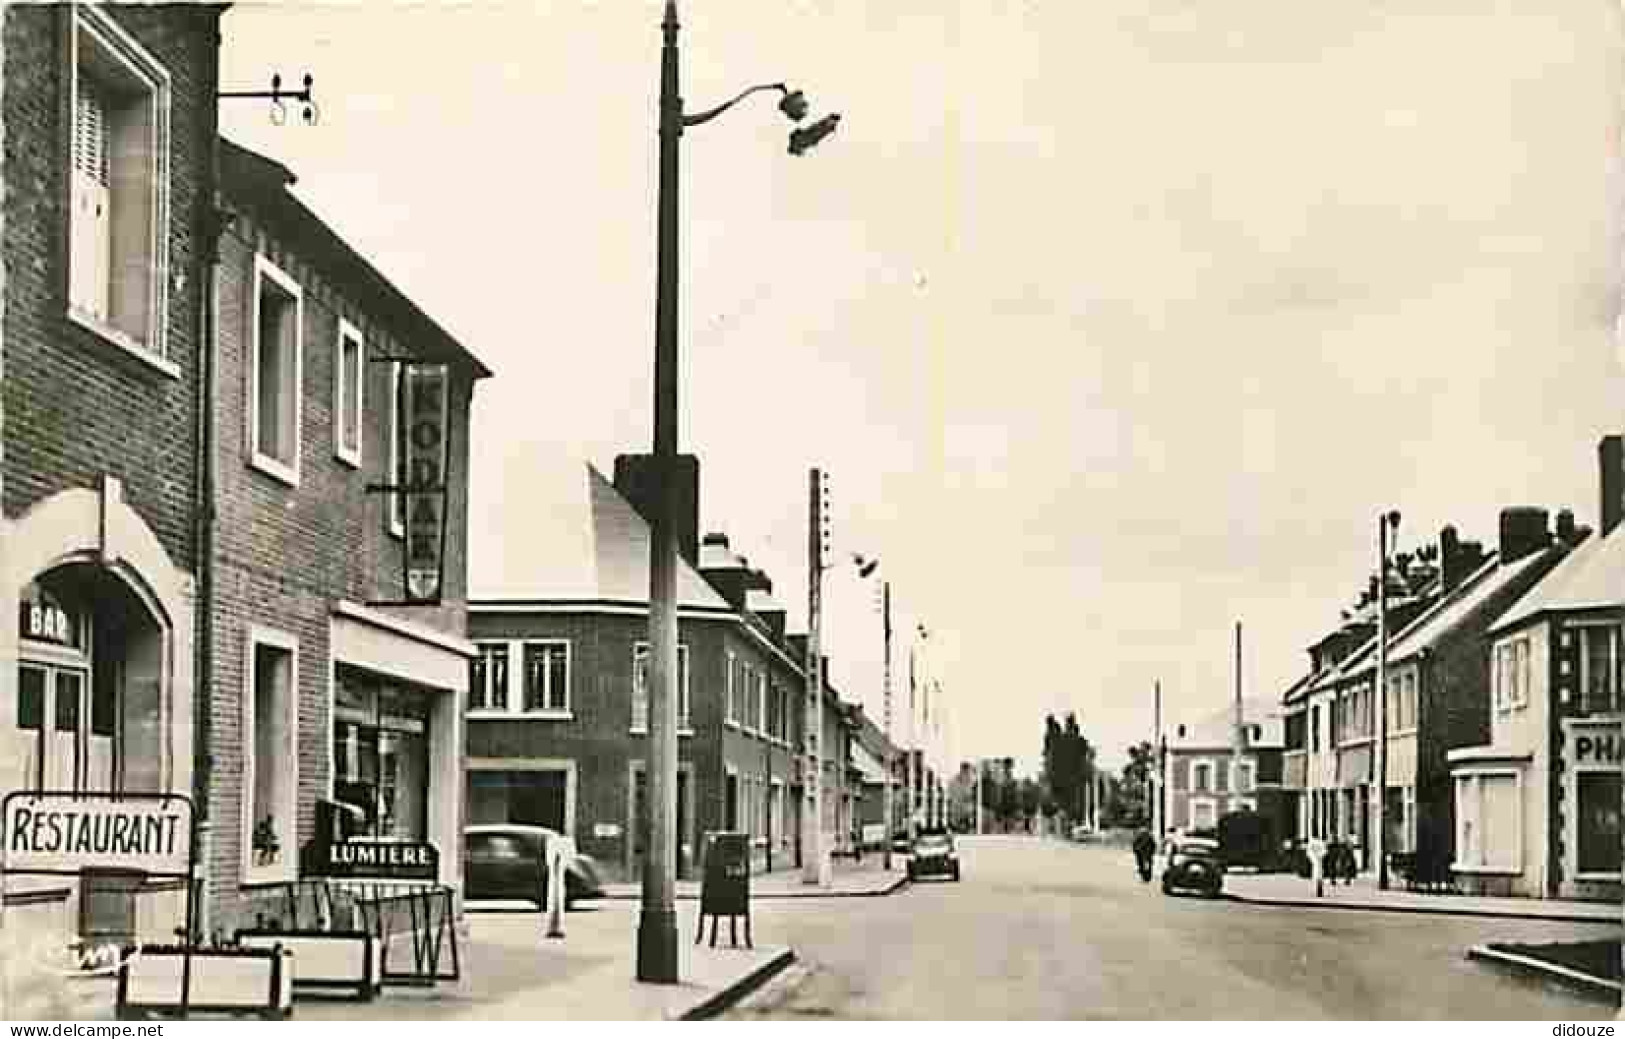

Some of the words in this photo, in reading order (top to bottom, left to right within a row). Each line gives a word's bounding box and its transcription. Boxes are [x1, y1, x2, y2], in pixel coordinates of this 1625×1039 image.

[411, 378, 442, 561] KODAK
[31, 606, 69, 639] BAR
[1575, 736, 1621, 762] PH
[13, 807, 180, 854] RESTAURANT
[330, 845, 433, 865] LUMIERE
